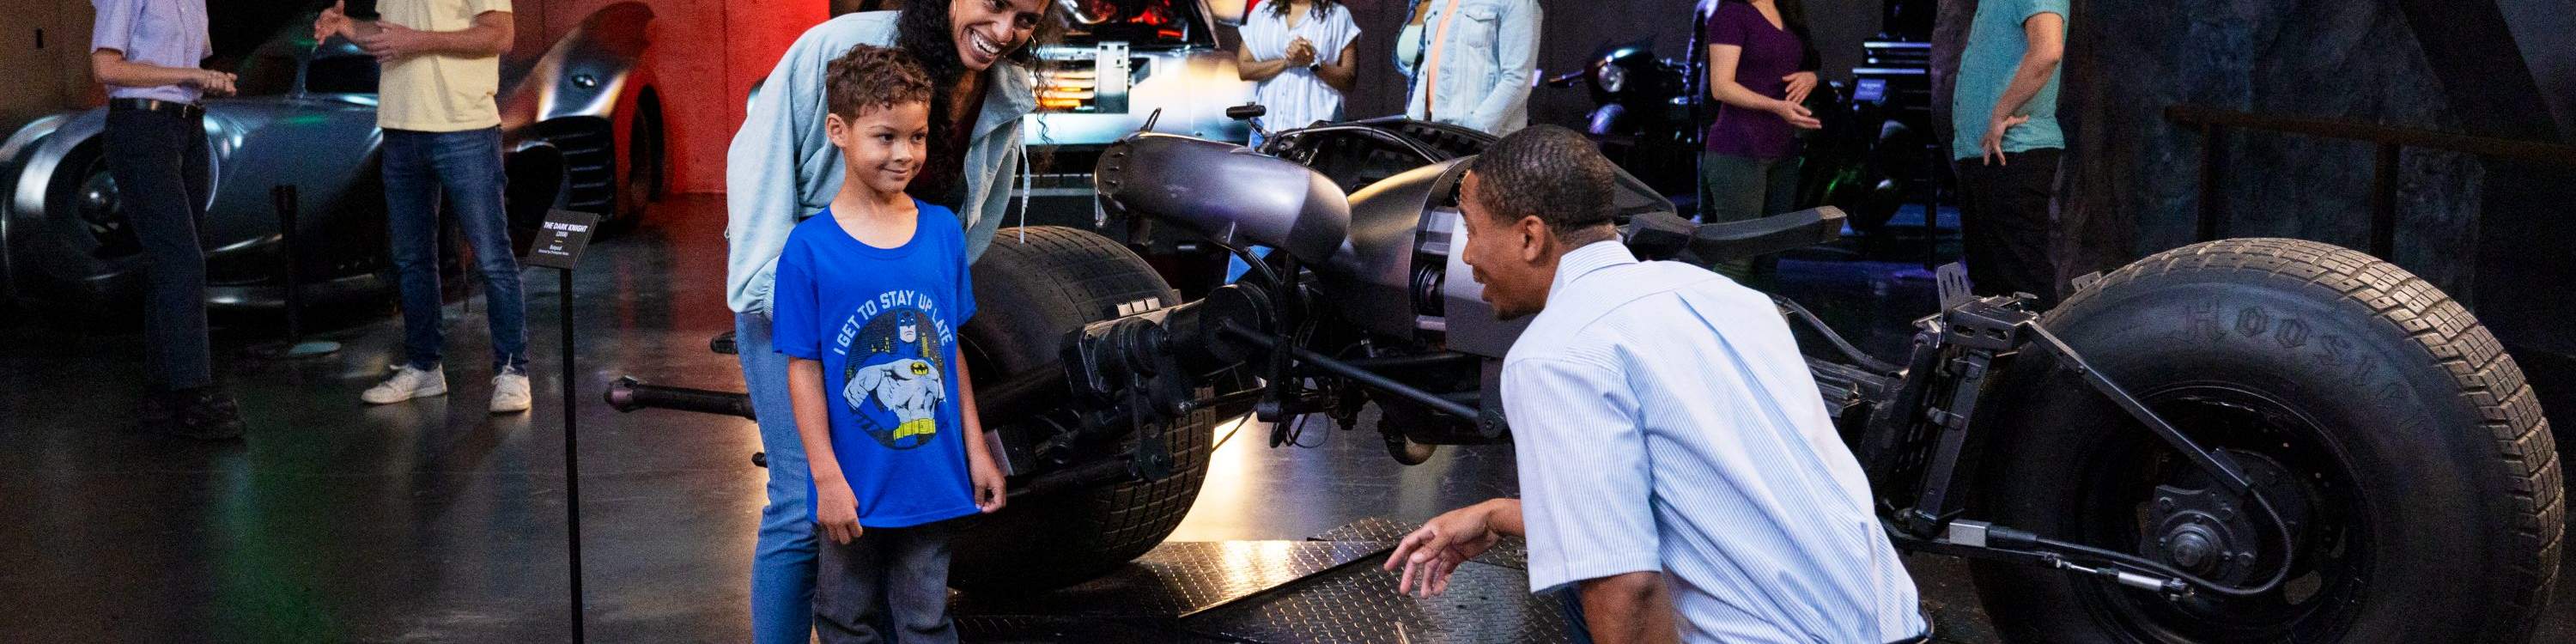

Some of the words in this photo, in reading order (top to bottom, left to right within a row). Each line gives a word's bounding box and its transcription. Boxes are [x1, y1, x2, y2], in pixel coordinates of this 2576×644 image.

[857, 299, 878, 320] TO
[879, 289, 915, 310] STAY
[918, 293, 933, 313] UP
[836, 315, 861, 348] GET
[932, 308, 954, 347] LATE
[833, 347, 846, 356] I
